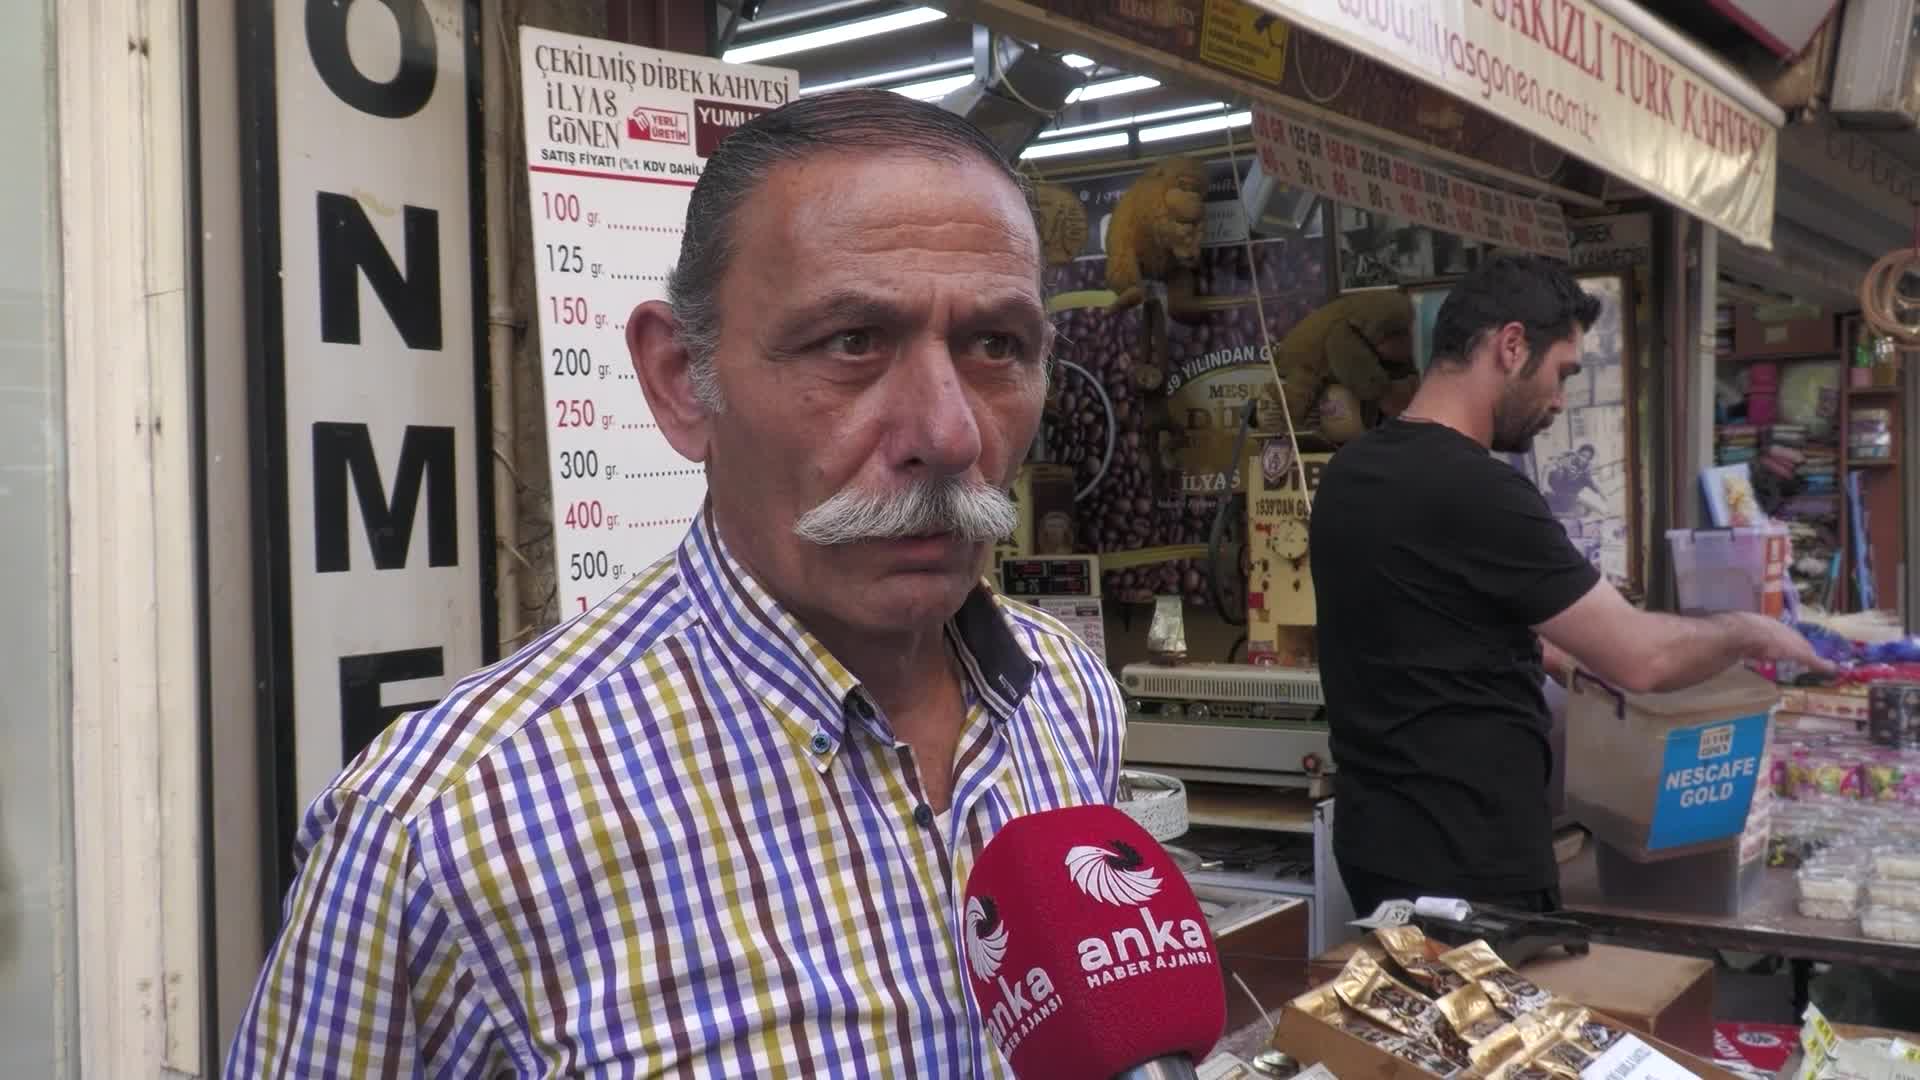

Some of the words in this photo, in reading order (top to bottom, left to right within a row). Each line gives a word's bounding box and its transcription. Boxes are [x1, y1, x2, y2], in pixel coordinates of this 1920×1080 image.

[535, 44, 637, 92] ÇEKİLMİŞ
[640, 57, 704, 96] DİBEK
[708, 73, 790, 105] KAHVESİ
[650, 114, 679, 130] YERLİ
[698, 104, 762, 129] YUM
[650, 126, 687, 141] ÜRETİM
[541, 149, 577, 166] SATIŞ
[579, 151, 616, 169] FİYATI
[643, 160, 667, 174] KDV
[542, 192, 580, 223] 100
[546, 244, 584, 274] 125
[550, 296, 588, 326] 150
[552, 348, 591, 377] 200
[1182, 346, 1254, 379] YILINDAN
[556, 400, 595, 428] 250
[560, 450, 598, 479] 300
[565, 501, 602, 529] 400
[570, 551, 608, 581] 500
[1665, 757, 1756, 790] NESCAFE
[1679, 782, 1733, 808] GOLD
[1077, 906, 1207, 972] anka
[1086, 960, 1151, 988] HABER
[1155, 951, 1212, 970] AJANSI
[987, 966, 1055, 1050] anka
[1020, 994, 1063, 1038] AJANSI
